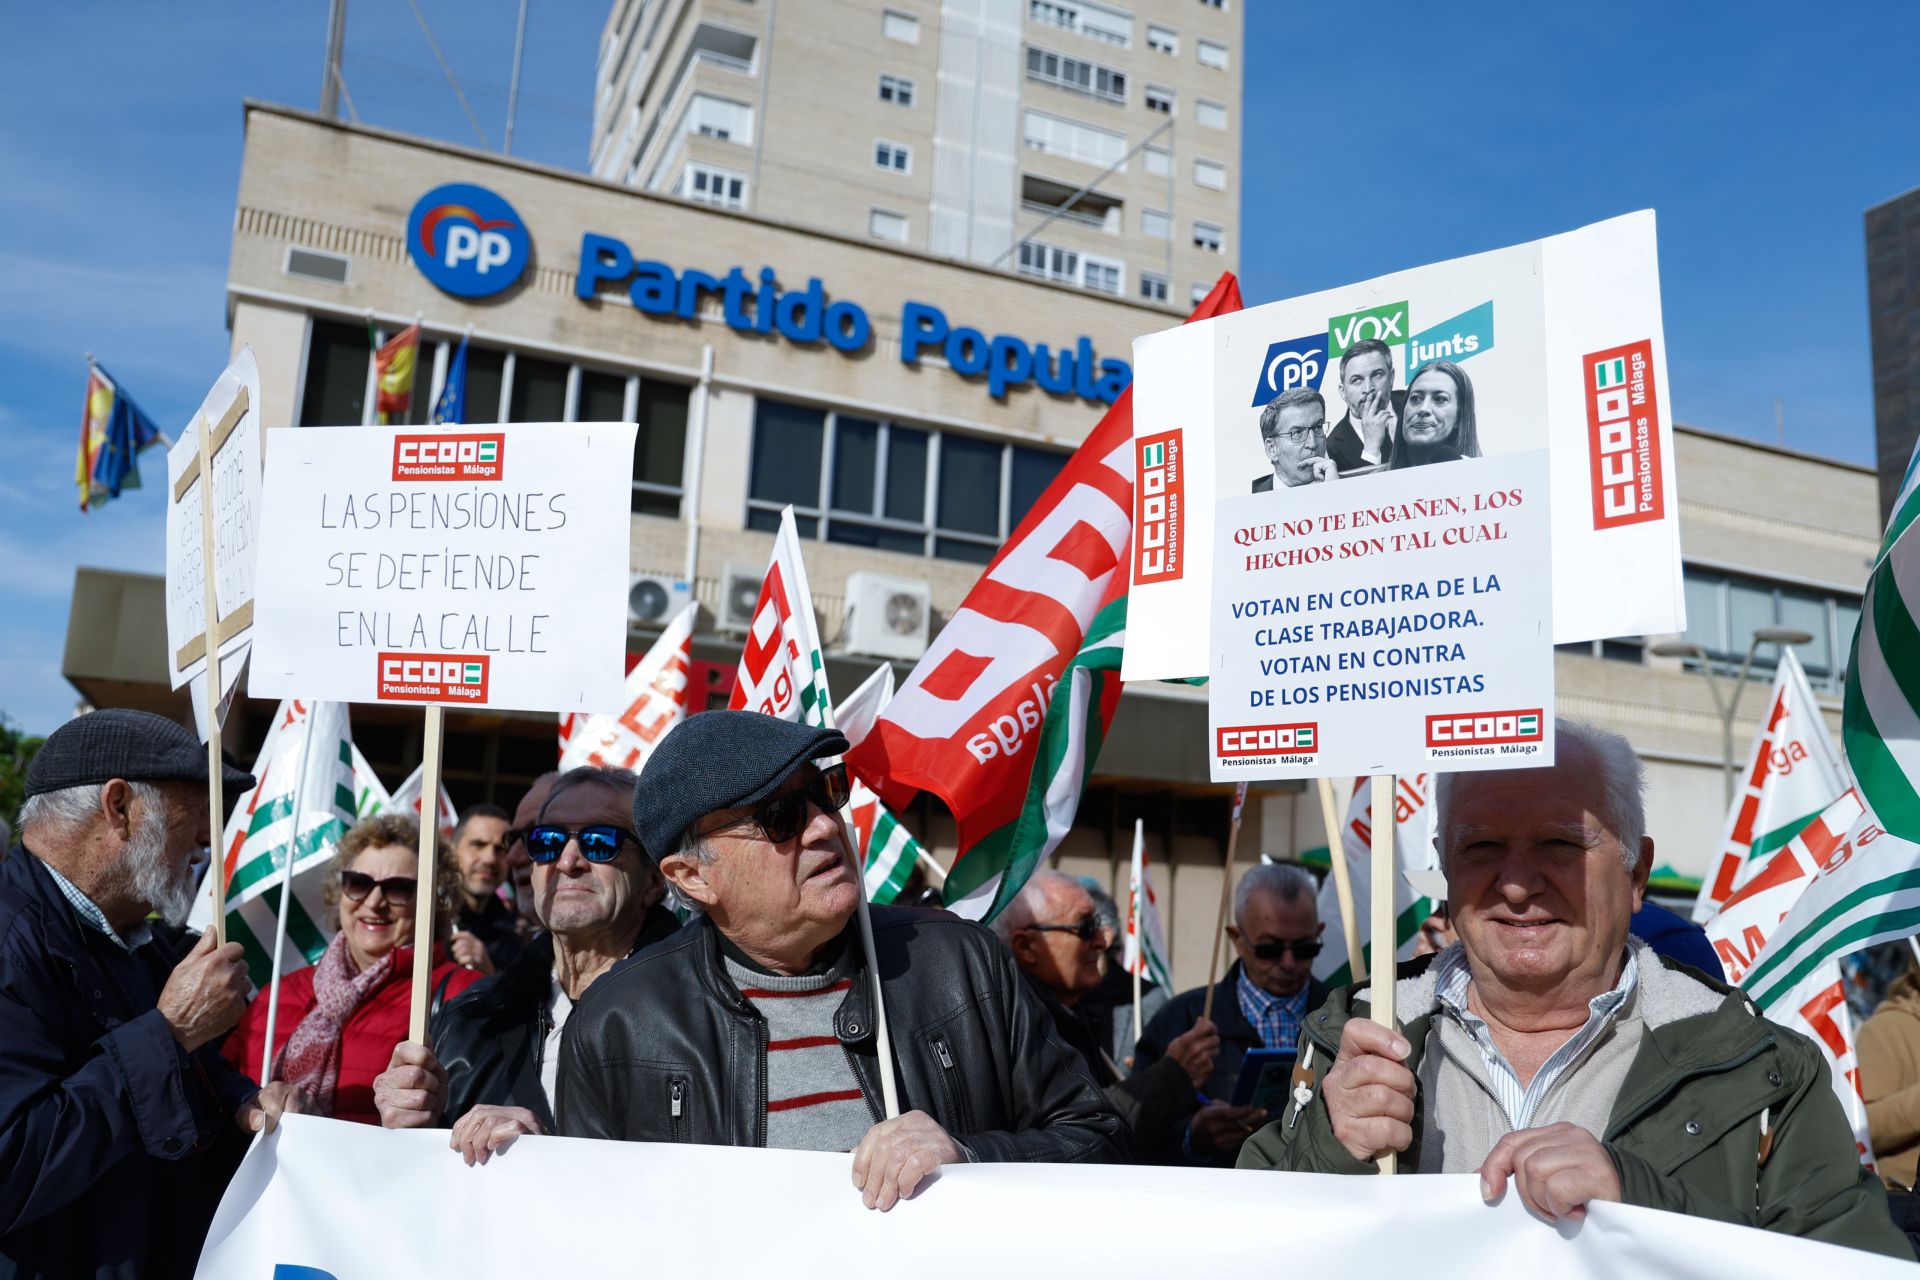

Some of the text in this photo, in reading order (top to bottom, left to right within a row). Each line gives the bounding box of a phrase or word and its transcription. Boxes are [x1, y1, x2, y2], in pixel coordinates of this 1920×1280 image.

[575, 232, 1133, 403] Partido Popula
[1334, 311, 1402, 349] VOX
[1410, 332, 1479, 369] junts
[1630, 352, 1653, 512] Pensionistas Málaga
[398, 464, 496, 476] Pensionistas Málaga
[399, 441, 477, 463] CCOO
[1597, 388, 1636, 518] CCOO
[321, 492, 381, 529] LAS
[1142, 468, 1165, 576] CCOO
[1166, 439, 1178, 572] Pensionistas Málaga
[1234, 488, 1523, 547] QUE NO TE ENGAÑEN, LOS
[1245, 522, 1507, 571] HECHOS SON TAL CUAL
[326, 552, 367, 589] SE
[1232, 575, 1501, 619] VOTAN EN CONTRA DE LA
[338, 611, 550, 653] EN LA CALLE
[1254, 609, 1484, 647] CLASE TRABAJADORA.
[383, 660, 461, 684] CCOO
[1260, 643, 1466, 676] VOTAN EN CONTRA
[383, 684, 481, 698] Pensionistas Málaga
[1250, 674, 1485, 707] DE LOS PENSIONISTAS
[1222, 729, 1295, 751] CCOO
[1432, 716, 1517, 741] CCOO
[1222, 754, 1313, 766] Pensionistas Málaga
[1432, 744, 1538, 757] Pensionistas Málaga
